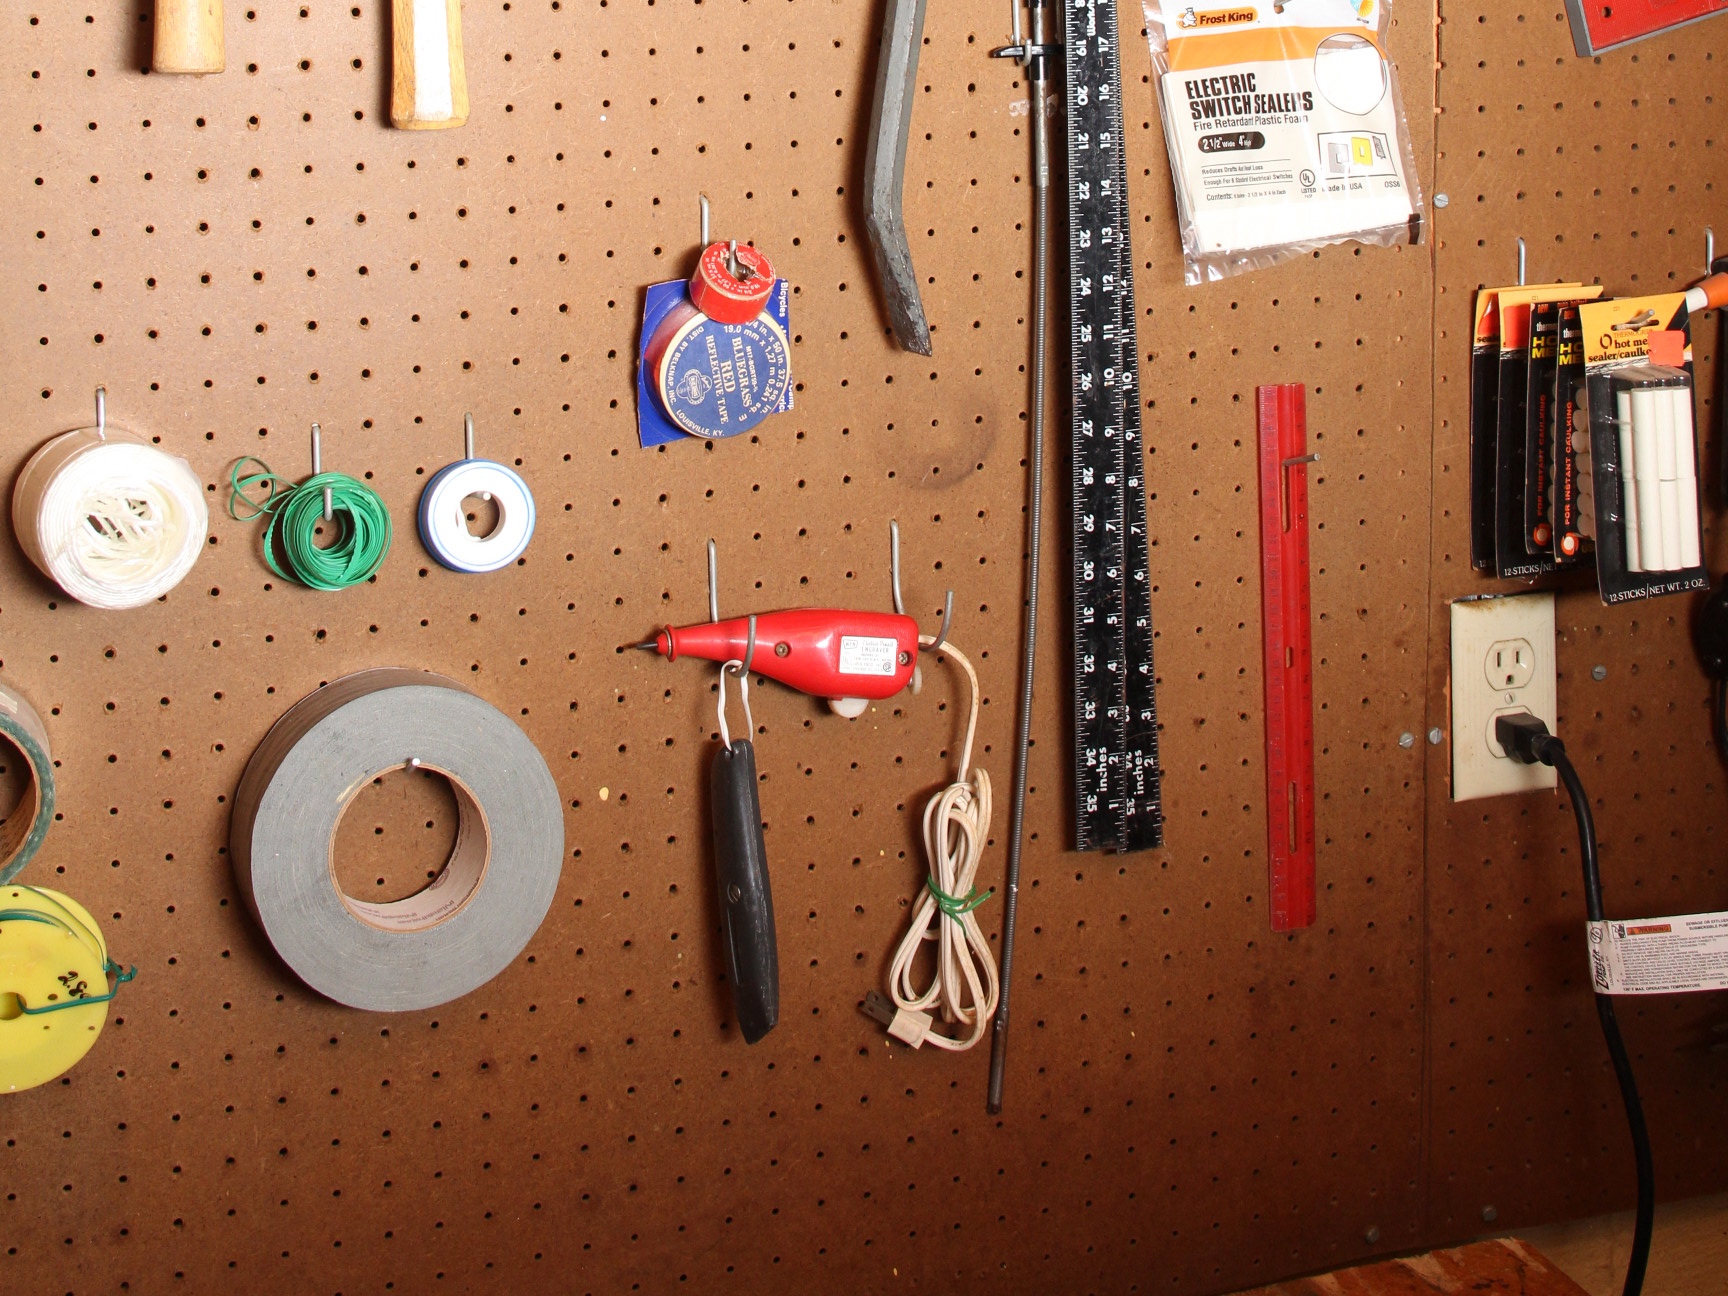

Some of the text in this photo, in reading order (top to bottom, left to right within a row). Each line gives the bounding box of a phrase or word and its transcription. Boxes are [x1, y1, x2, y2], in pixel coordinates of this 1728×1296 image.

[1200, 11, 1254, 24] Frost King
[1075, 39, 1087, 56] 19
[1097, 37, 1109, 53] 17
[1077, 85, 1088, 105] 20
[1098, 84, 1110, 101] 16
[1185, 72, 1256, 100] ELECTRIC
[1190, 94, 1252, 120] SWITCH
[1194, 121, 1212, 131] Fire
[1255, 115, 1282, 126] Plastic
[1078, 133, 1089, 150] 21
[1100, 132, 1111, 149] 15
[1079, 182, 1090, 200] 22
[1101, 179, 1112, 196] 14
[1079, 230, 1091, 248] 23
[1101, 227, 1113, 244] 13
[1080, 278, 1091, 296] 24
[1102, 274, 1113, 292] 12
[778, 282, 789, 318] Bicycles
[686, 326, 704, 341] DIST.
[743, 328, 760, 341] mm
[759, 325, 767, 336] in.
[773, 343, 782, 353] 50
[1081, 324, 1092, 342] 25
[1103, 324, 1114, 340] 11
[680, 342, 689, 352] BY
[1614, 339, 1631, 349] hot
[706, 334, 729, 425] REFLECTIVE TAPE
[721, 360, 736, 393] RED
[732, 336, 753, 408] BLUEGRASS
[1104, 368, 1114, 387] 10
[1081, 372, 1092, 391] 26
[668, 389, 677, 406] INC.
[712, 429, 725, 437] KY.
[1082, 419, 1093, 437] 27
[1565, 401, 1573, 453] CAULKING
[1083, 467, 1093, 485] 28
[1083, 514, 1094, 532] 29
[1083, 560, 1094, 581] 30
[1667, 581, 1682, 592] WT.
[1690, 578, 1706, 588] OZ.
[1083, 607, 1094, 624] 31
[1083, 654, 1094, 673] 32
[1085, 701, 1096, 720] 33
[1085, 748, 1096, 767] 34
[1096, 746, 1107, 792] inches
[1133, 750, 1144, 795] inches
[1087, 795, 1097, 812] 35
